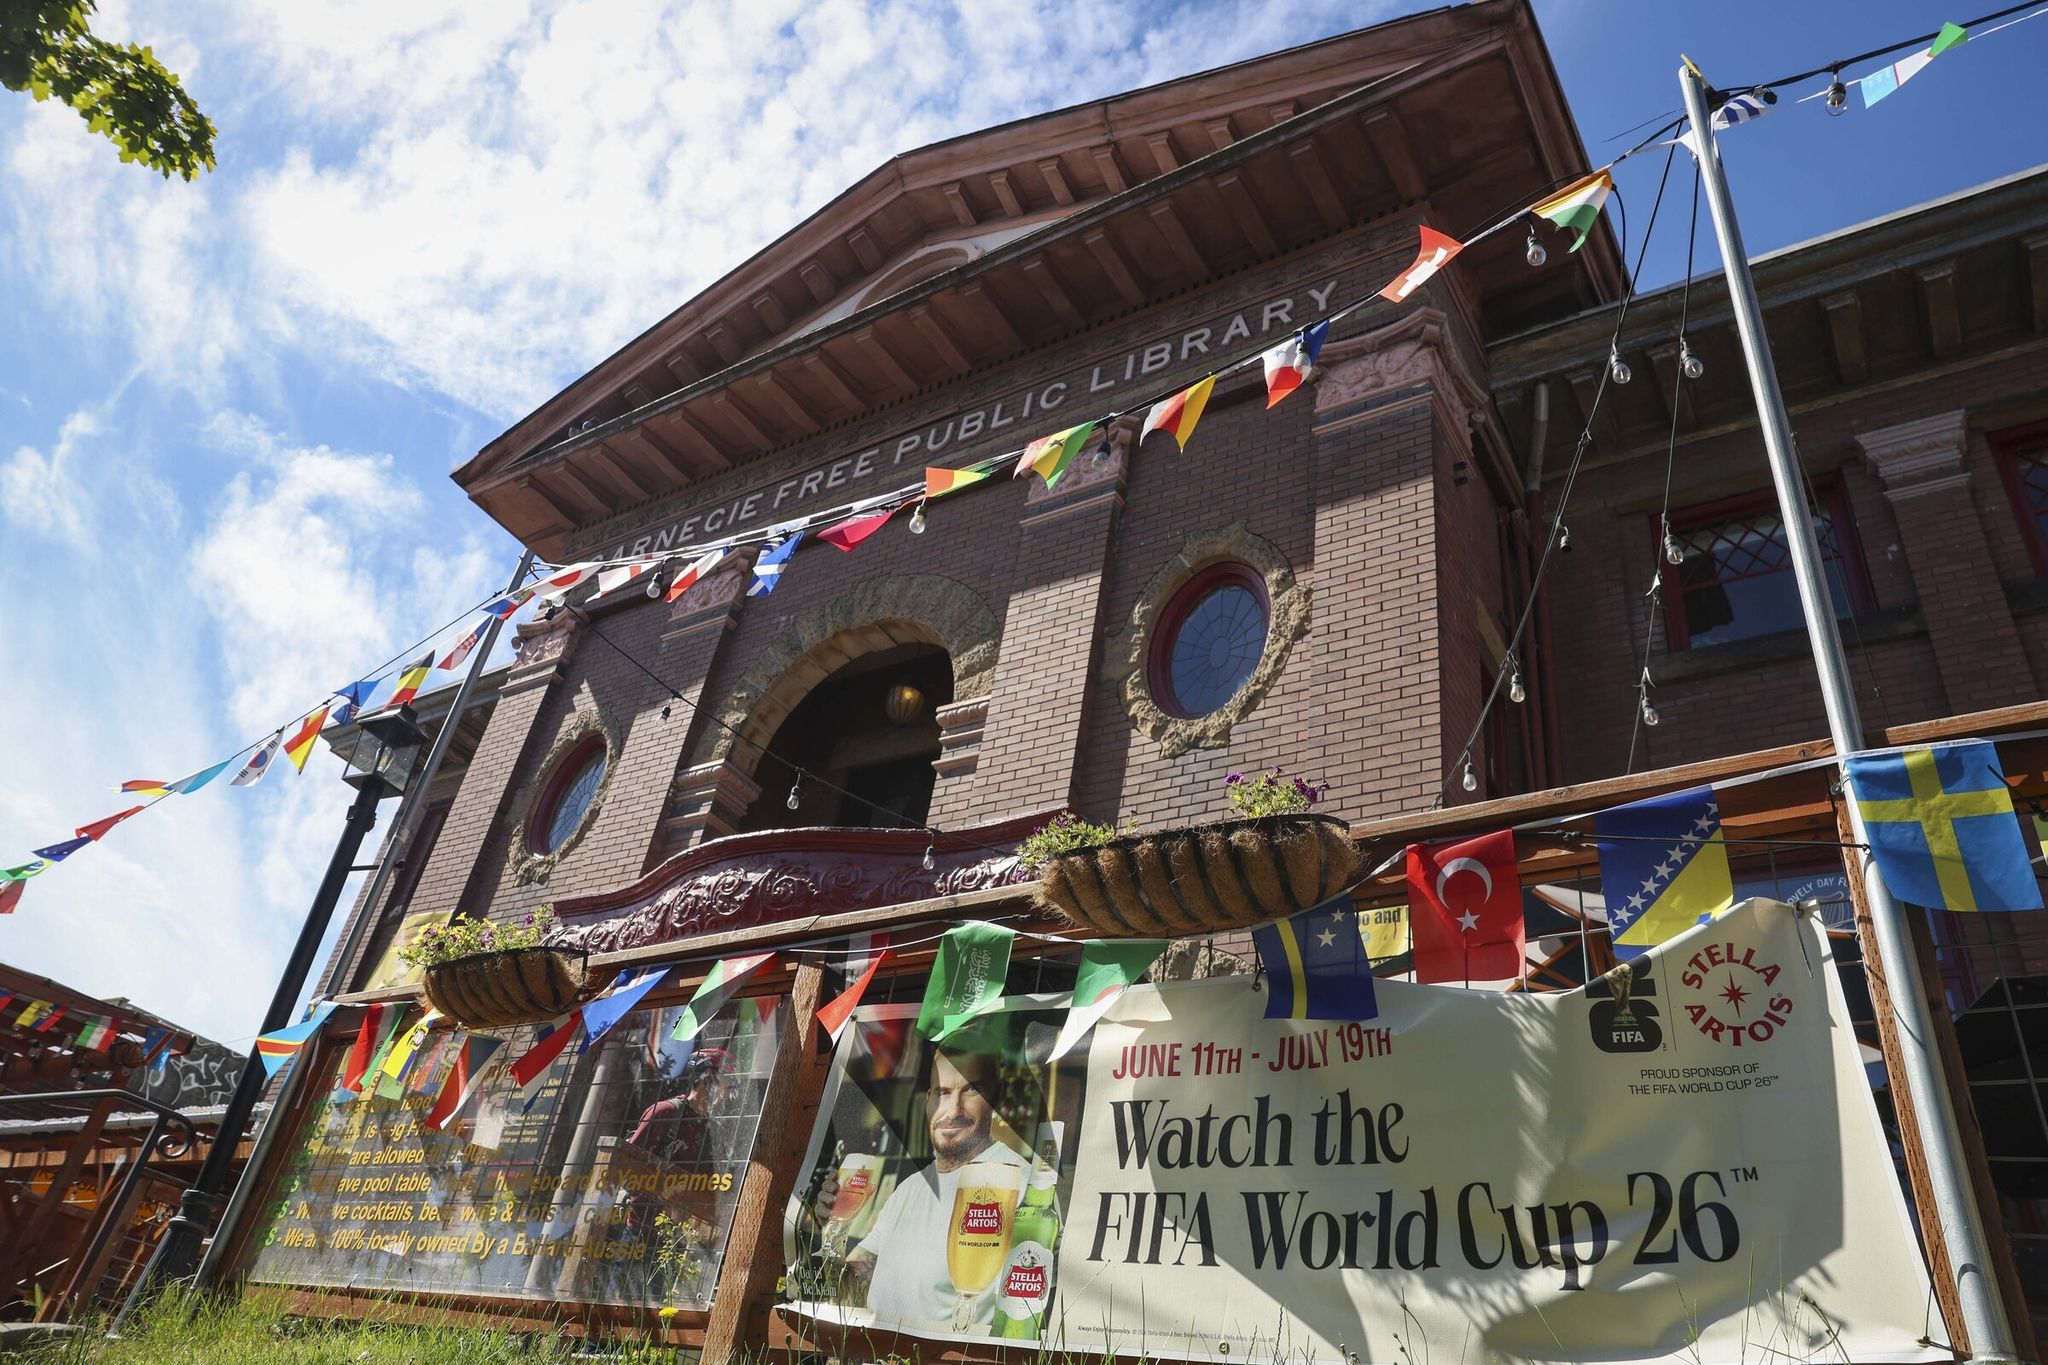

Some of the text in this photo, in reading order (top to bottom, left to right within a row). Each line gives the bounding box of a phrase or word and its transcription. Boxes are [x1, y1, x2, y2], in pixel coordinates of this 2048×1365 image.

[772, 448, 880, 510] FREE
[893, 382, 1068, 465] PUBLIC
[1089, 280, 1341, 393] LIBRARY
[1786, 882, 1814, 904] OVELY
[1817, 877, 1836, 888] DAY
[1375, 907, 1401, 924] and
[1681, 942, 1782, 990] STELLA
[1612, 1030, 1646, 1044] FIFA
[1112, 1042, 1182, 1080] JUNE
[1191, 1041, 1242, 1076] 11TH
[1268, 1028, 1329, 1072] JULY
[1335, 1022, 1392, 1063] 19TH
[1640, 1062, 1761, 1080] PROUD SPONSOR OF
[1628, 1083, 1651, 1096] THE
[1653, 1083, 1676, 1095] FIFA
[1678, 1081, 1724, 1094] WORLD
[1725, 1079, 1752, 1091] CUP
[364, 1121, 378, 1138] is
[1109, 1087, 1409, 1170] Watch the
[349, 1150, 372, 1165] are
[372, 1146, 425, 1165] allowed
[335, 1175, 360, 1193] ave
[360, 1173, 394, 1196] pool
[395, 1173, 432, 1194] table,
[618, 1168, 663, 1191] Yard
[663, 1173, 732, 1198] games
[350, 1201, 414, 1224] cocktails,
[500, 1201, 514, 1222] &
[968, 1209, 998, 1218] STELLA
[967, 1218, 998, 1228] ARTOIS
[284, 1228, 304, 1247] We
[329, 1229, 367, 1250] 100%
[367, 1228, 416, 1257] locally
[416, 1231, 471, 1253] owned
[471, 1231, 496, 1260] By
[497, 1237, 509, 1255] a
[1086, 1191, 1221, 1268] FIFA
[1240, 1185, 1441, 1272] World
[1456, 1180, 1609, 1293] Cup
[800, 1266, 822, 1279] Daid
[1010, 1271, 1042, 1282] STELLA
[1008, 1280, 1042, 1292] ARTOIS
